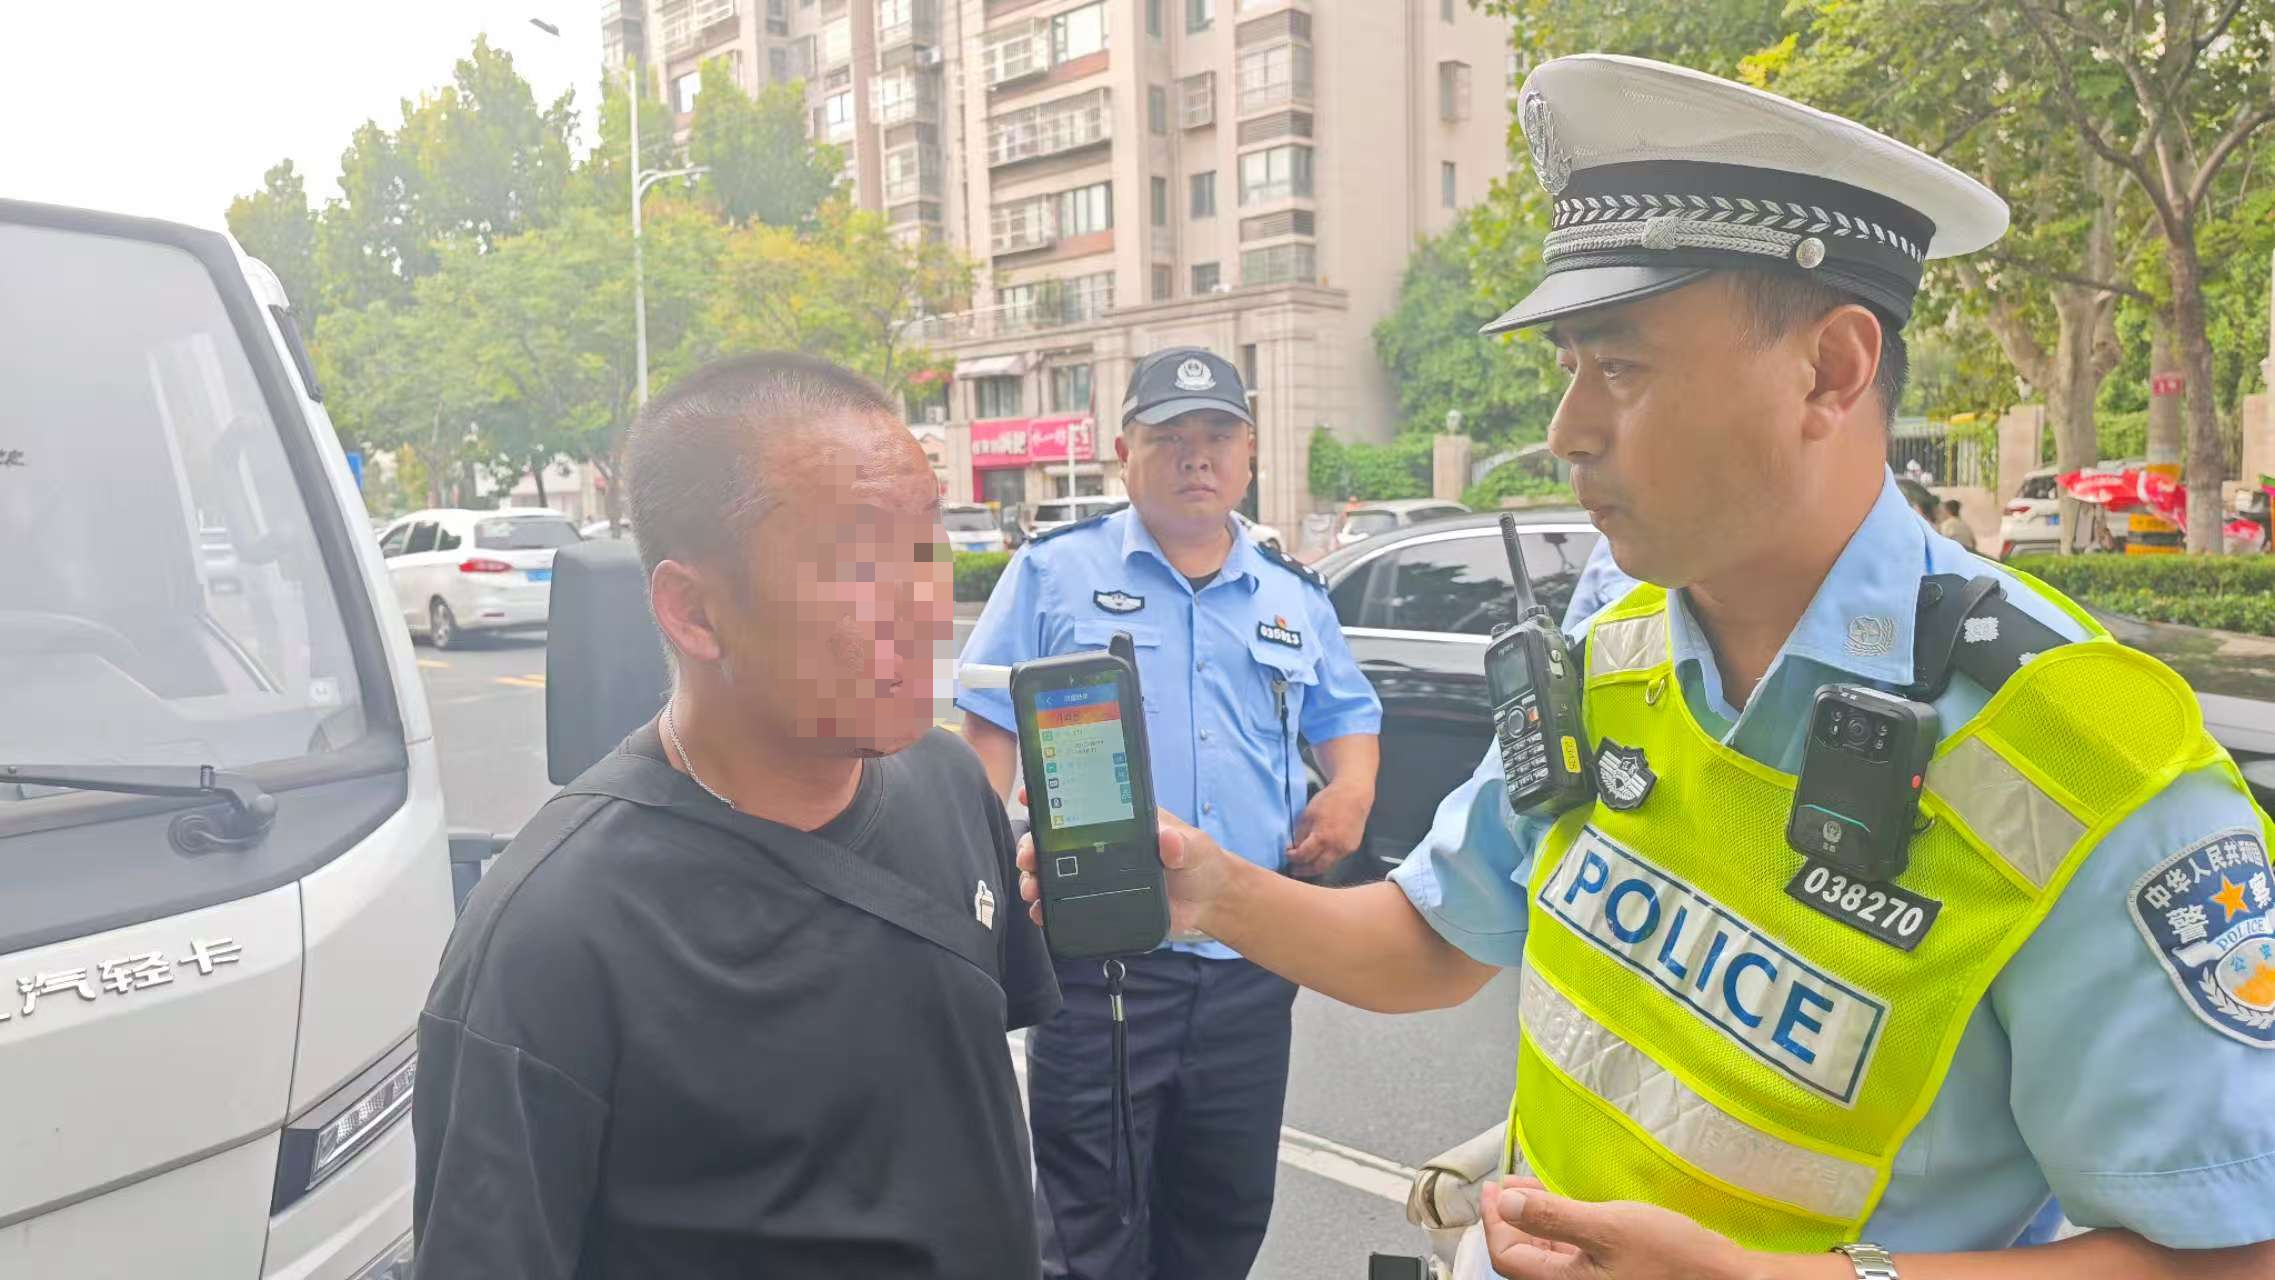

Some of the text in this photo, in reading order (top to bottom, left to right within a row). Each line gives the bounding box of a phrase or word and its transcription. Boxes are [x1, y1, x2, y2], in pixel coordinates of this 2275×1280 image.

[1803, 866, 1925, 937] 038270
[2216, 918, 2265, 951] POLICE
[0, 936, 243, 1022] 汽轻卡
[1563, 848, 1836, 1066] POLICE
